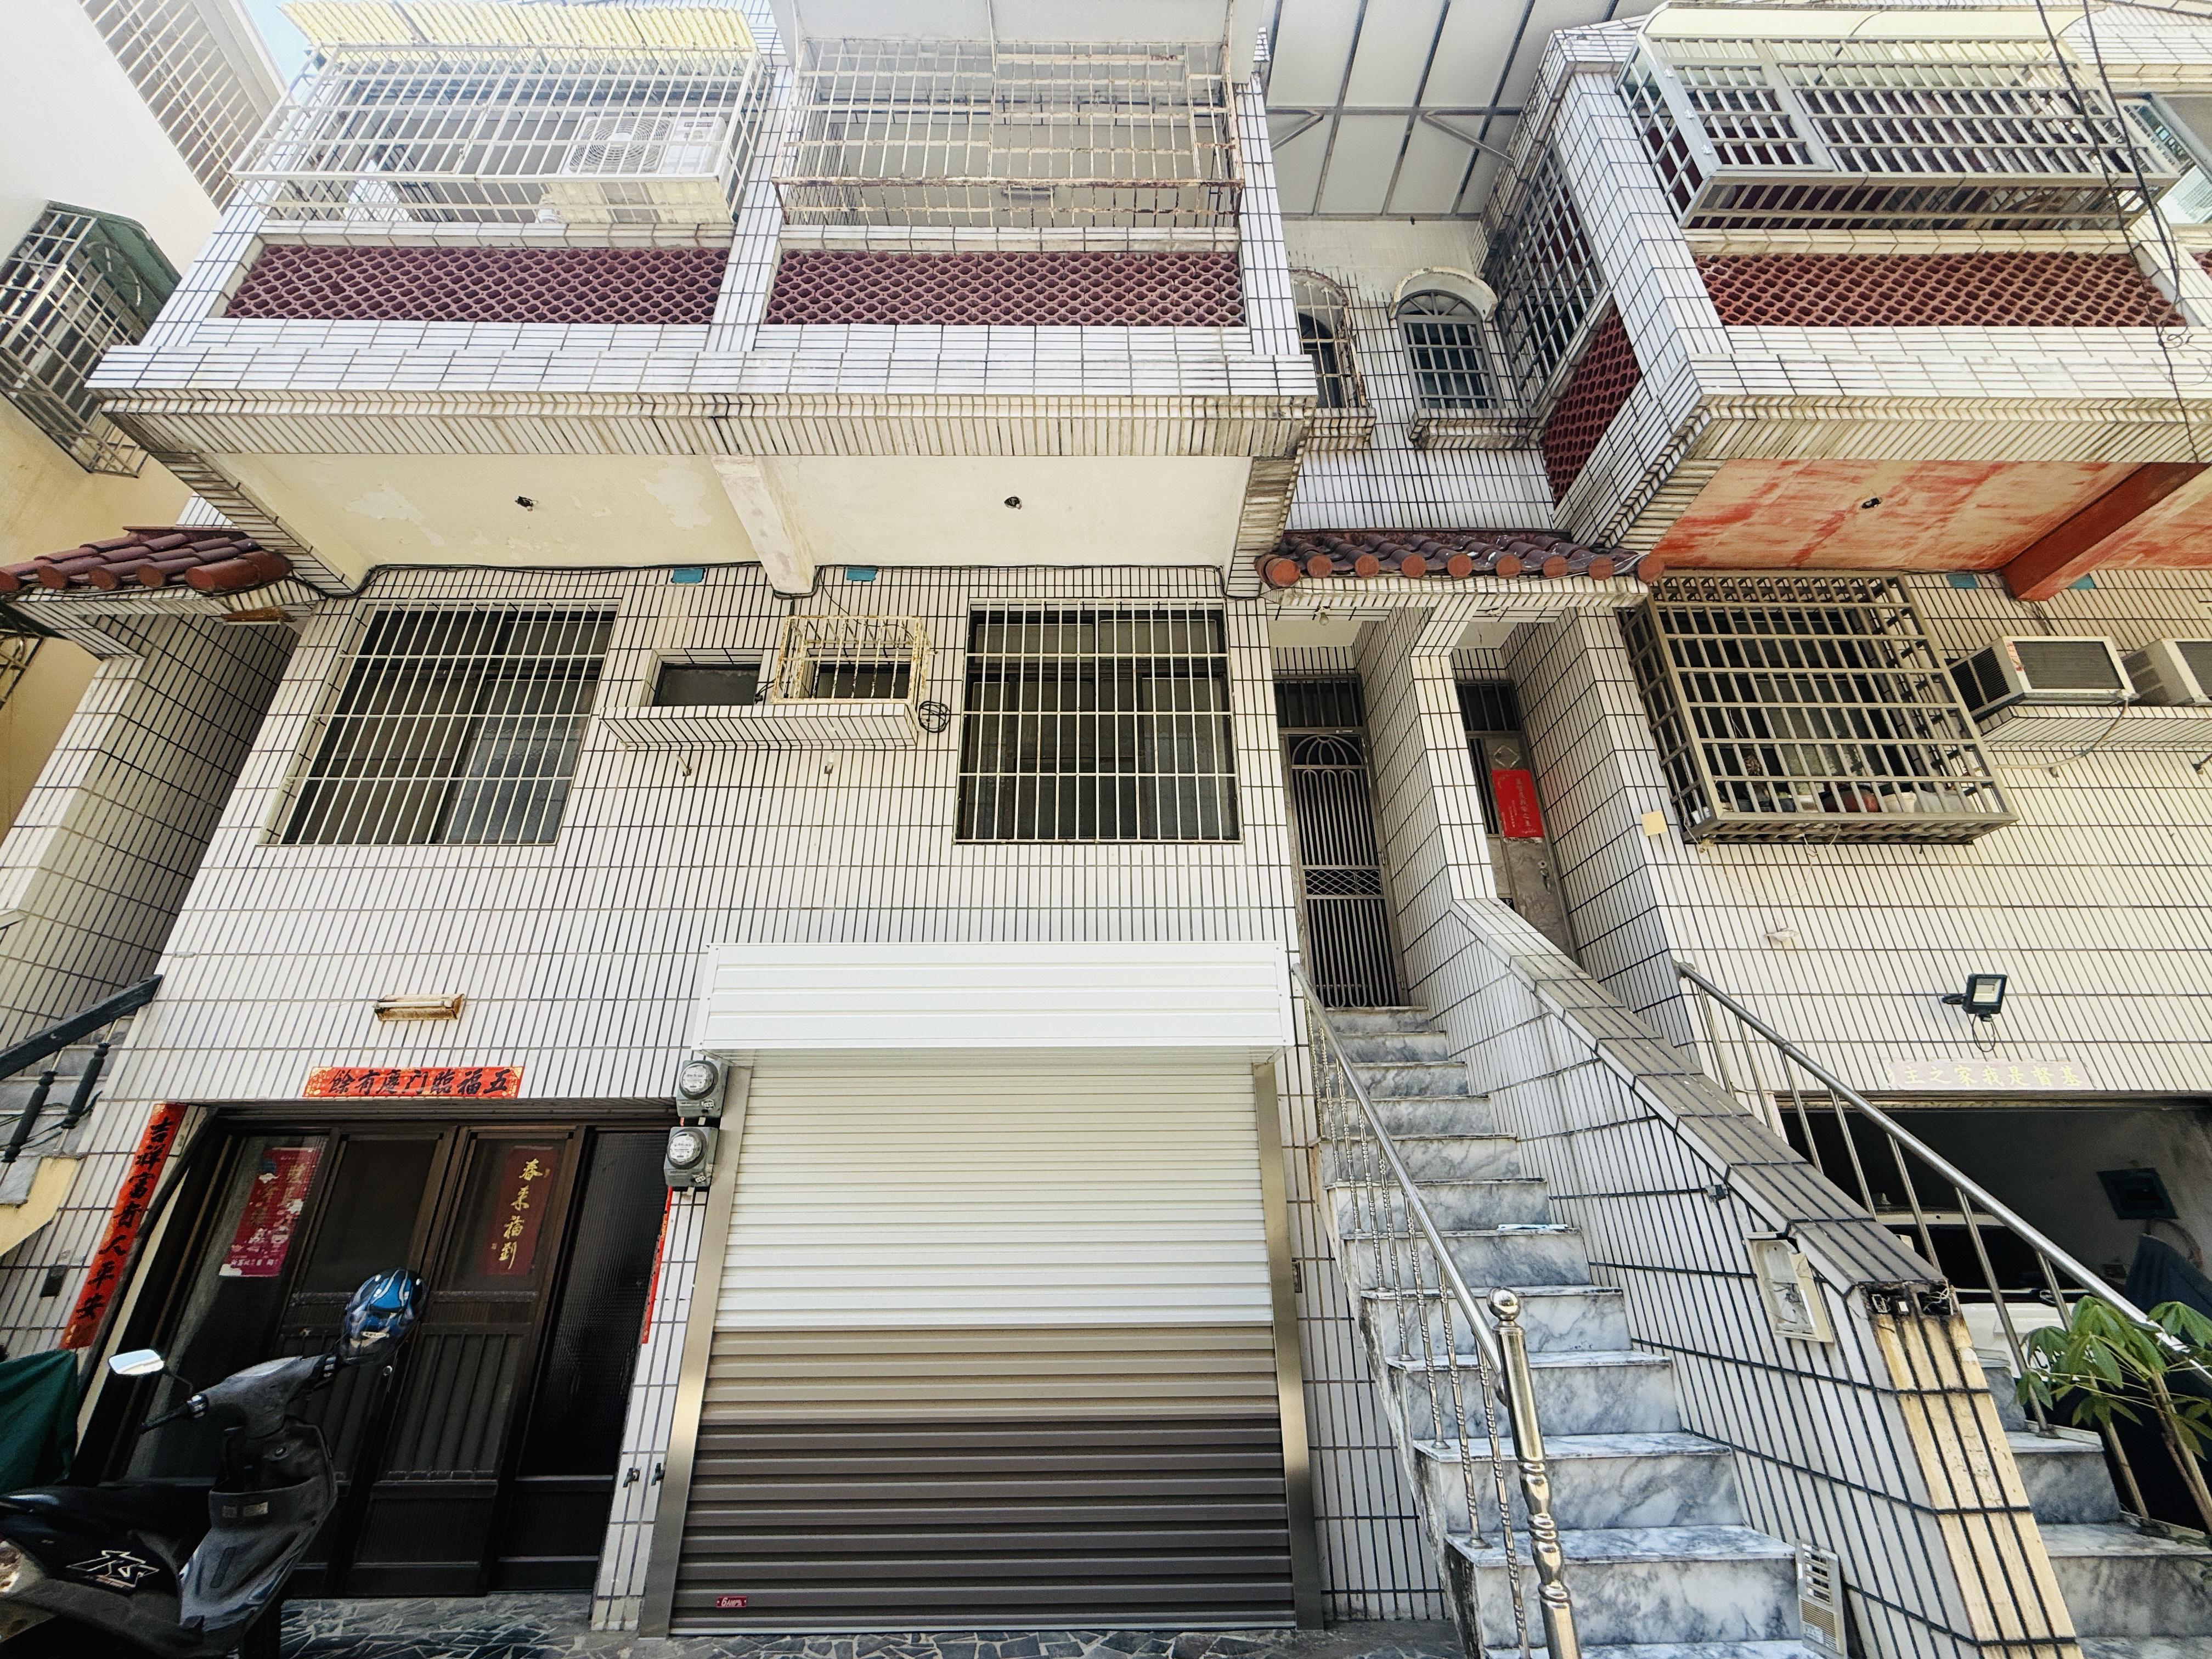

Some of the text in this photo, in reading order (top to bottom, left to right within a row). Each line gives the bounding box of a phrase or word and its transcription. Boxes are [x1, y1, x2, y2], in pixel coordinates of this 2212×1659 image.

[1903, 1064, 2083, 1087] 基督是我家之主
